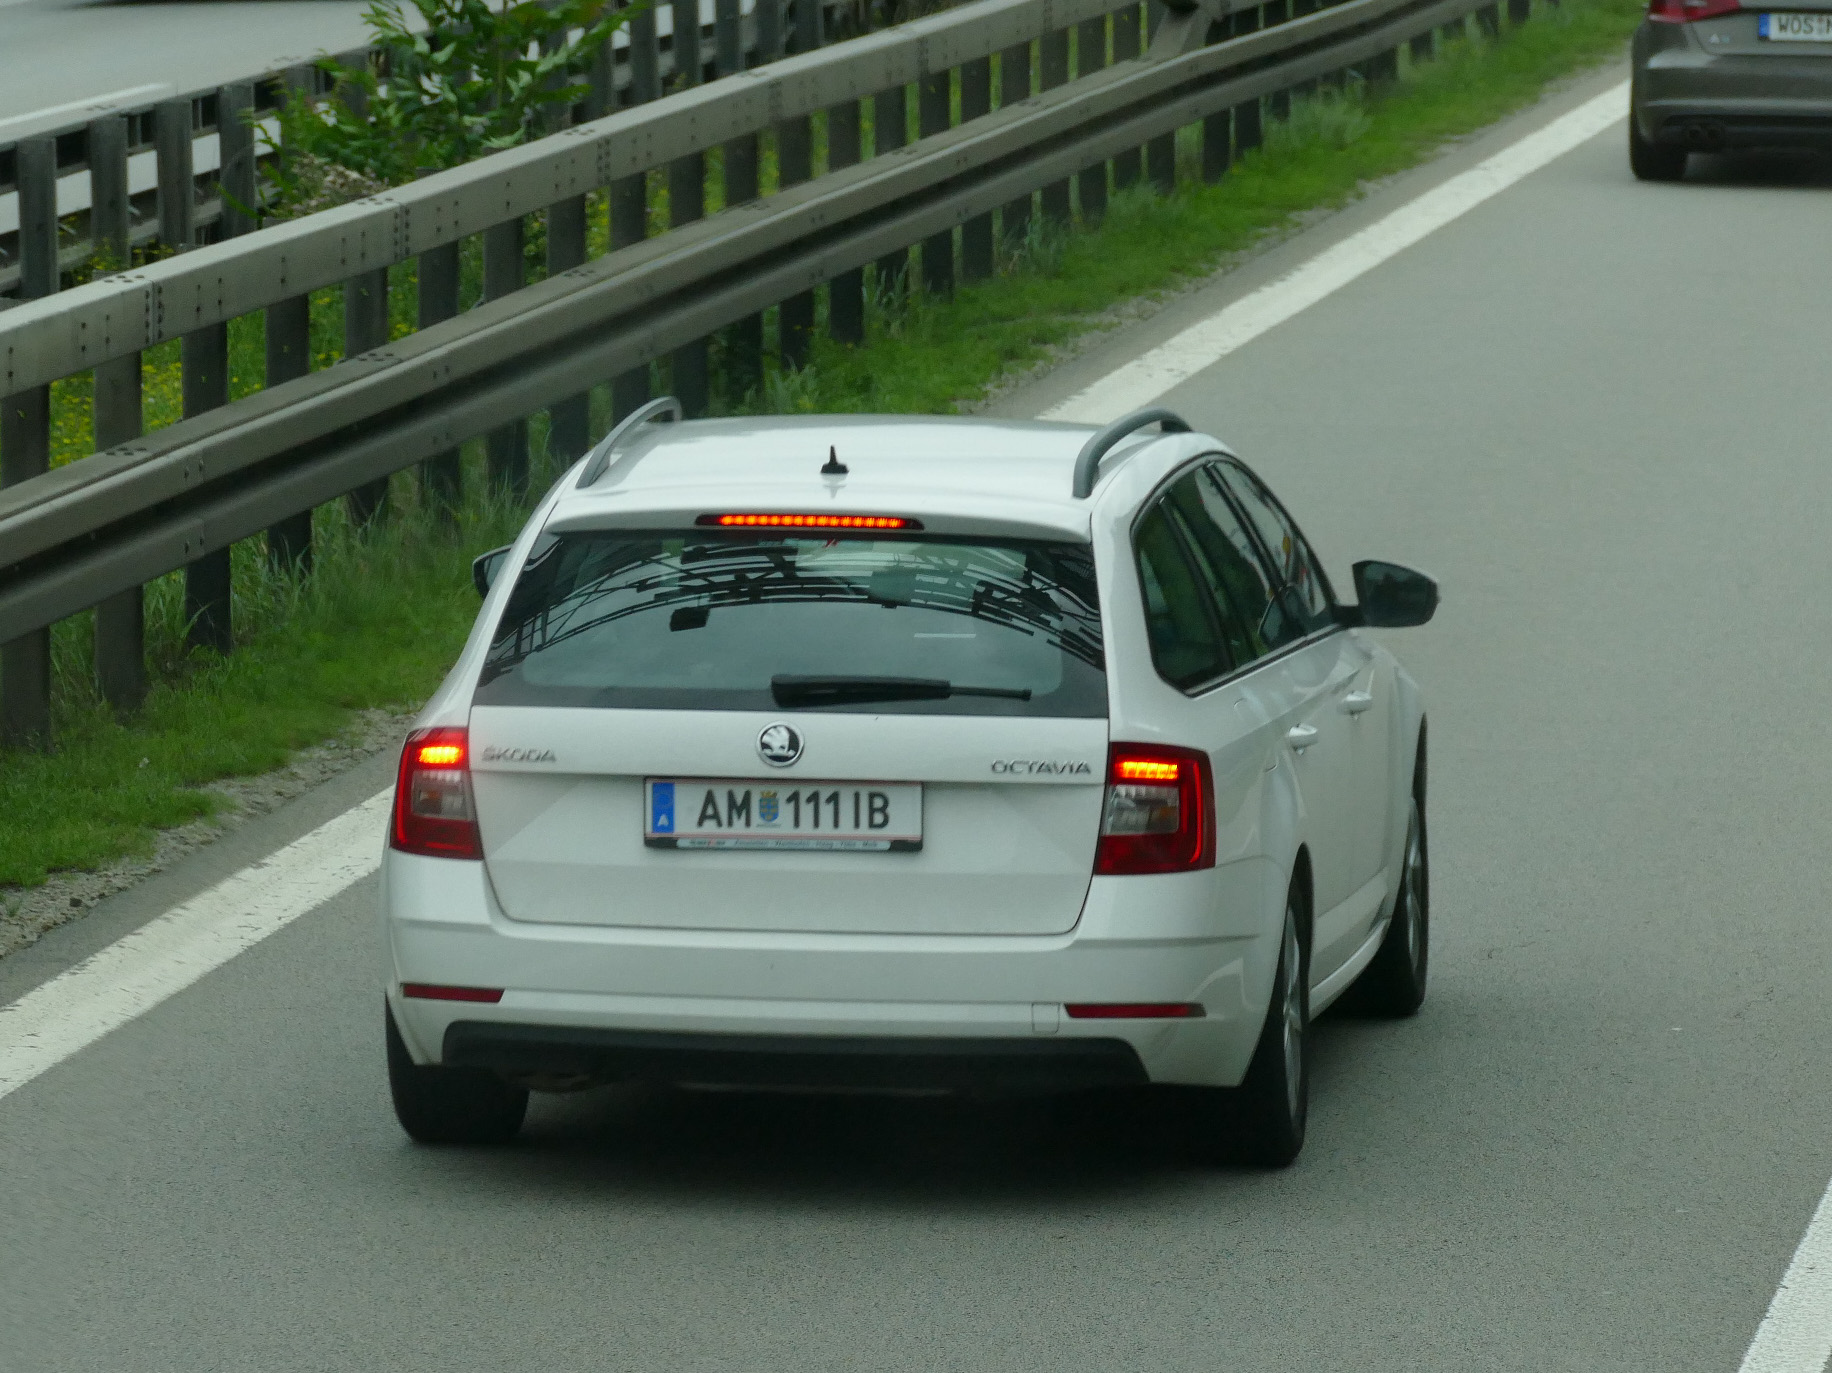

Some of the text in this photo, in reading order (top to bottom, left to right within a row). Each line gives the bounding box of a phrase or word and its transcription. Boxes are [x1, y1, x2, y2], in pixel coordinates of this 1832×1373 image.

[991, 759, 1091, 774] OCTAVIA
[697, 789, 751, 828] AM
[657, 813, 670, 827] A
